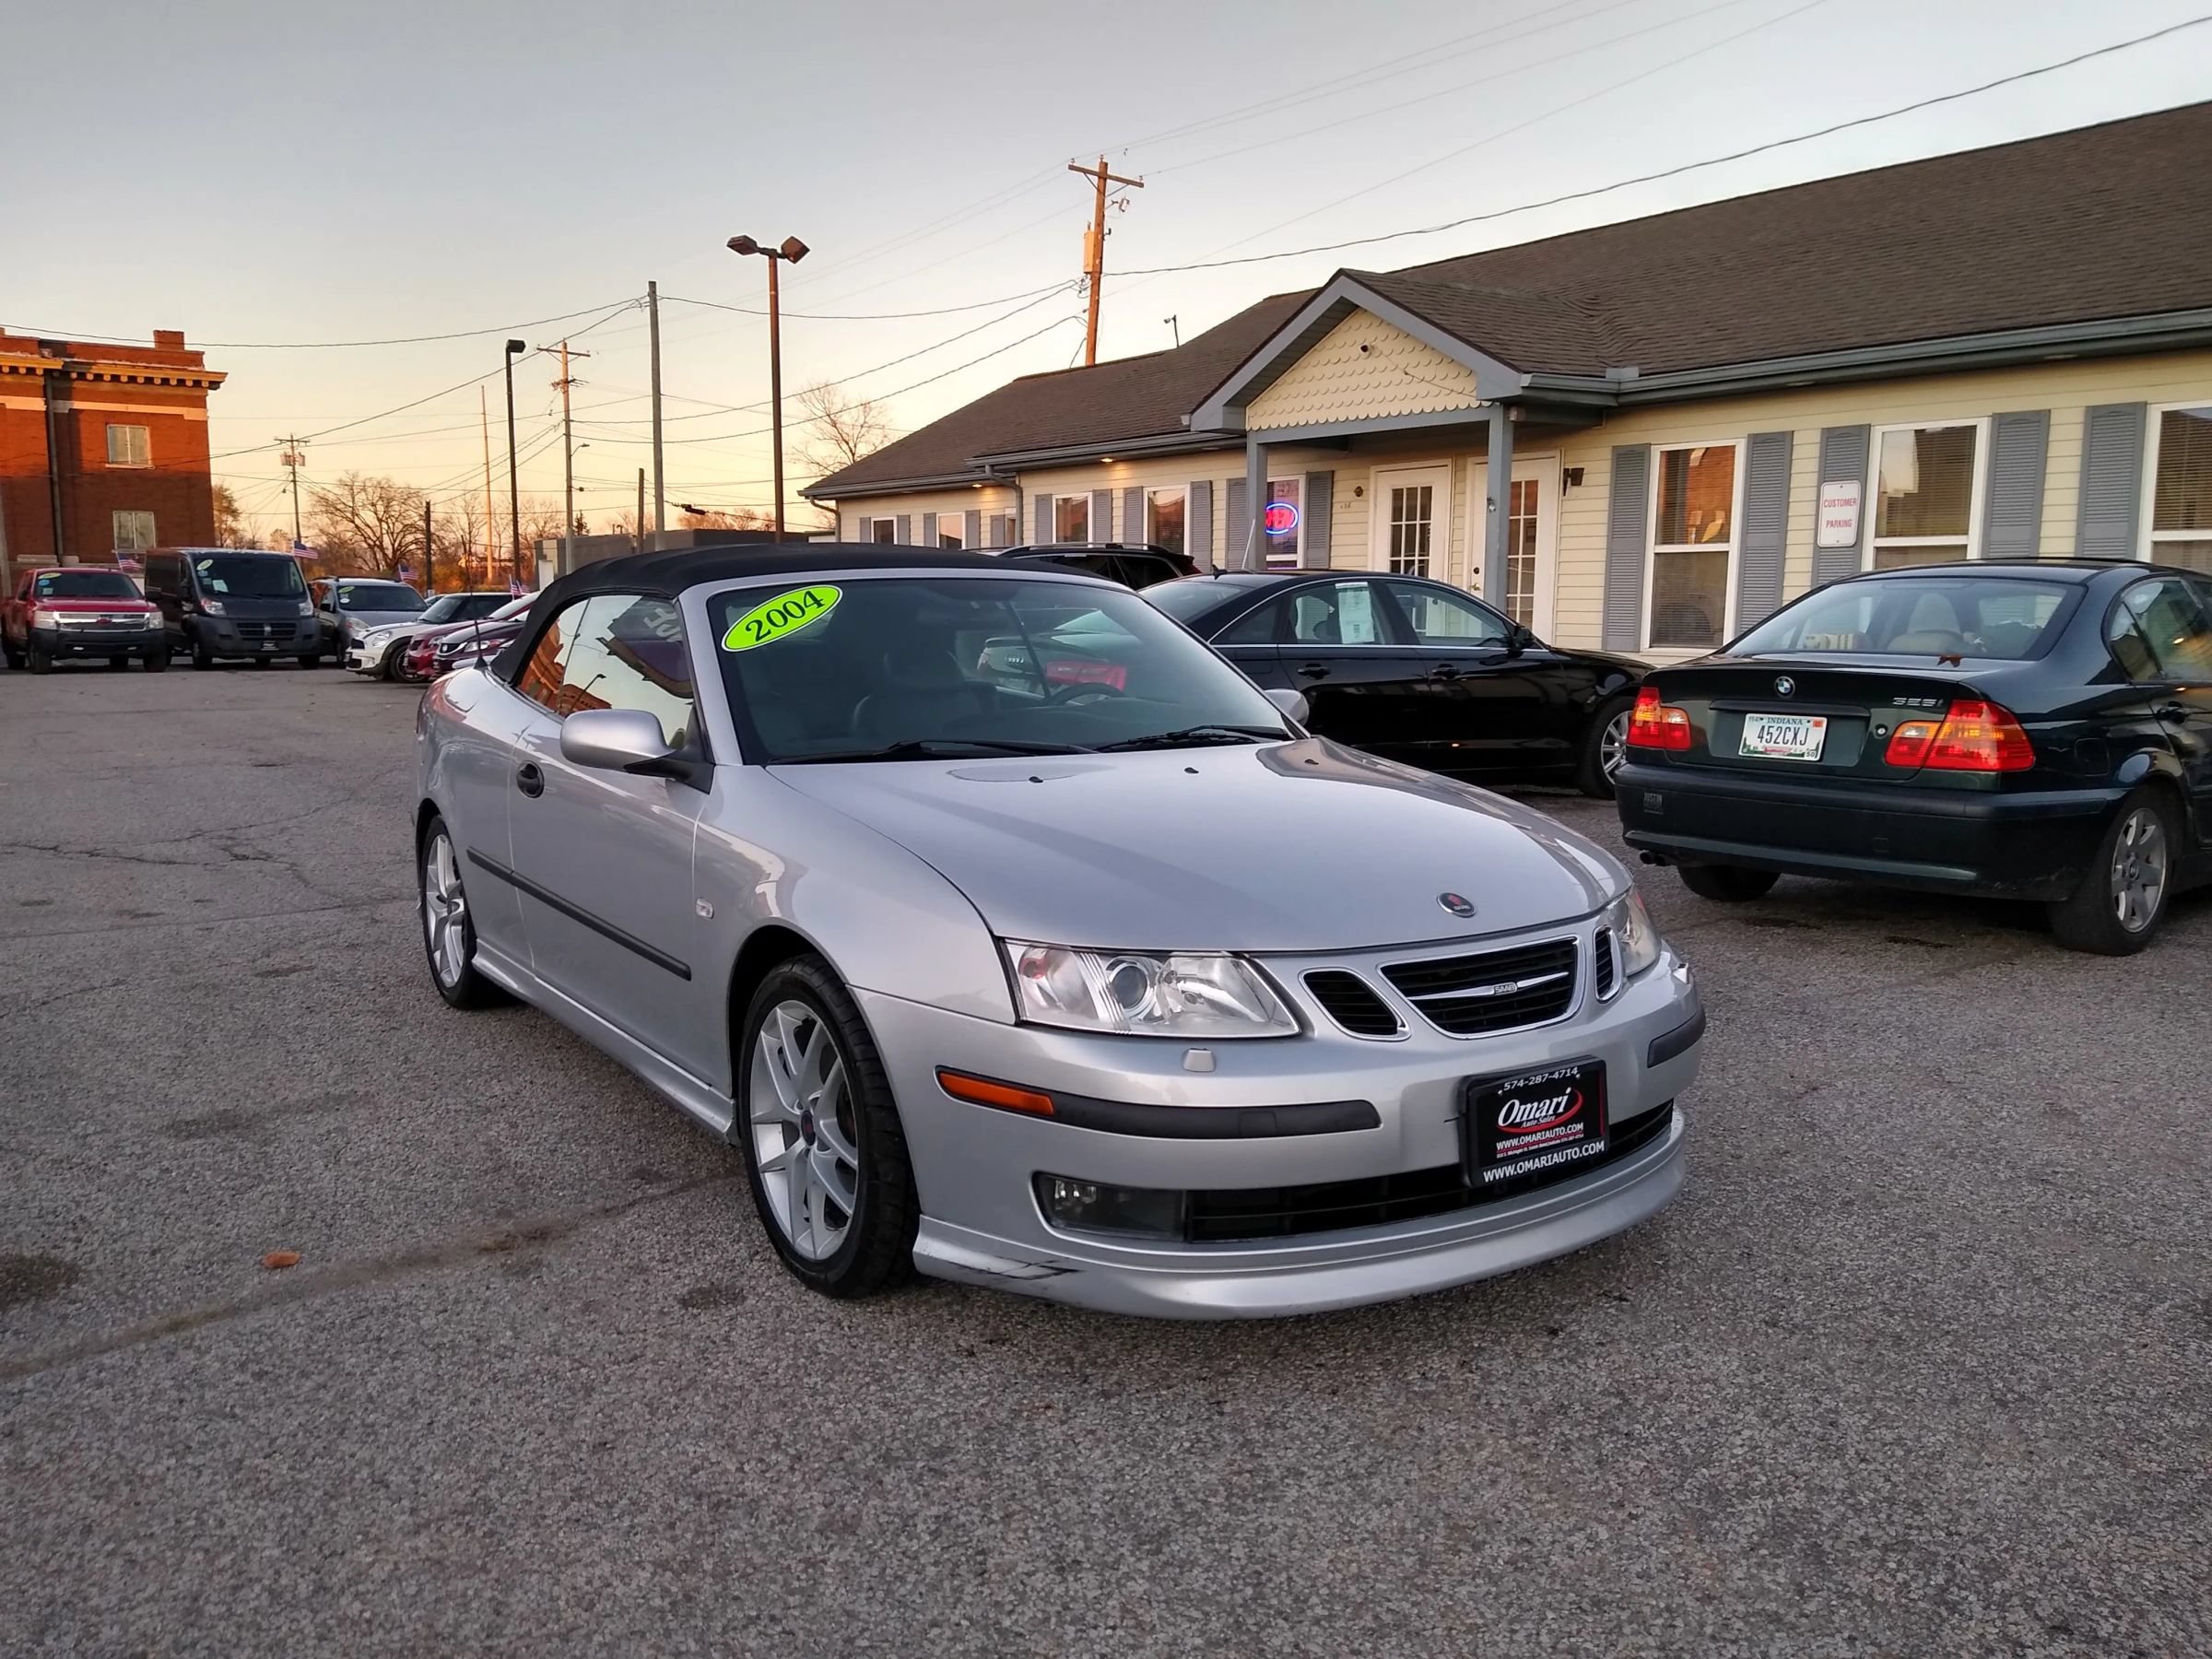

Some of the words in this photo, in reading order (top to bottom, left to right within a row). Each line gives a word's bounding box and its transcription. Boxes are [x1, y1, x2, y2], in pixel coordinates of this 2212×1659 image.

[1824, 498, 1857, 508] CUSTOMER
[1826, 519, 1853, 528] PARKING
[745, 590, 826, 642] 2004
[1767, 717, 1803, 725] INDIANA
[1758, 724, 1809, 746] 452CXJ
[1503, 1066, 1578, 1090] 574-287-4714
[1498, 1087, 1571, 1126] Omari
[1520, 1117, 1537, 1128] Auto
[1537, 1115, 1556, 1124] Sales
[1496, 1123, 1583, 1150] WWW.OMARIAUTO.COM
[1483, 1140, 1605, 1182] WWW.OMARIAUTO.COM
